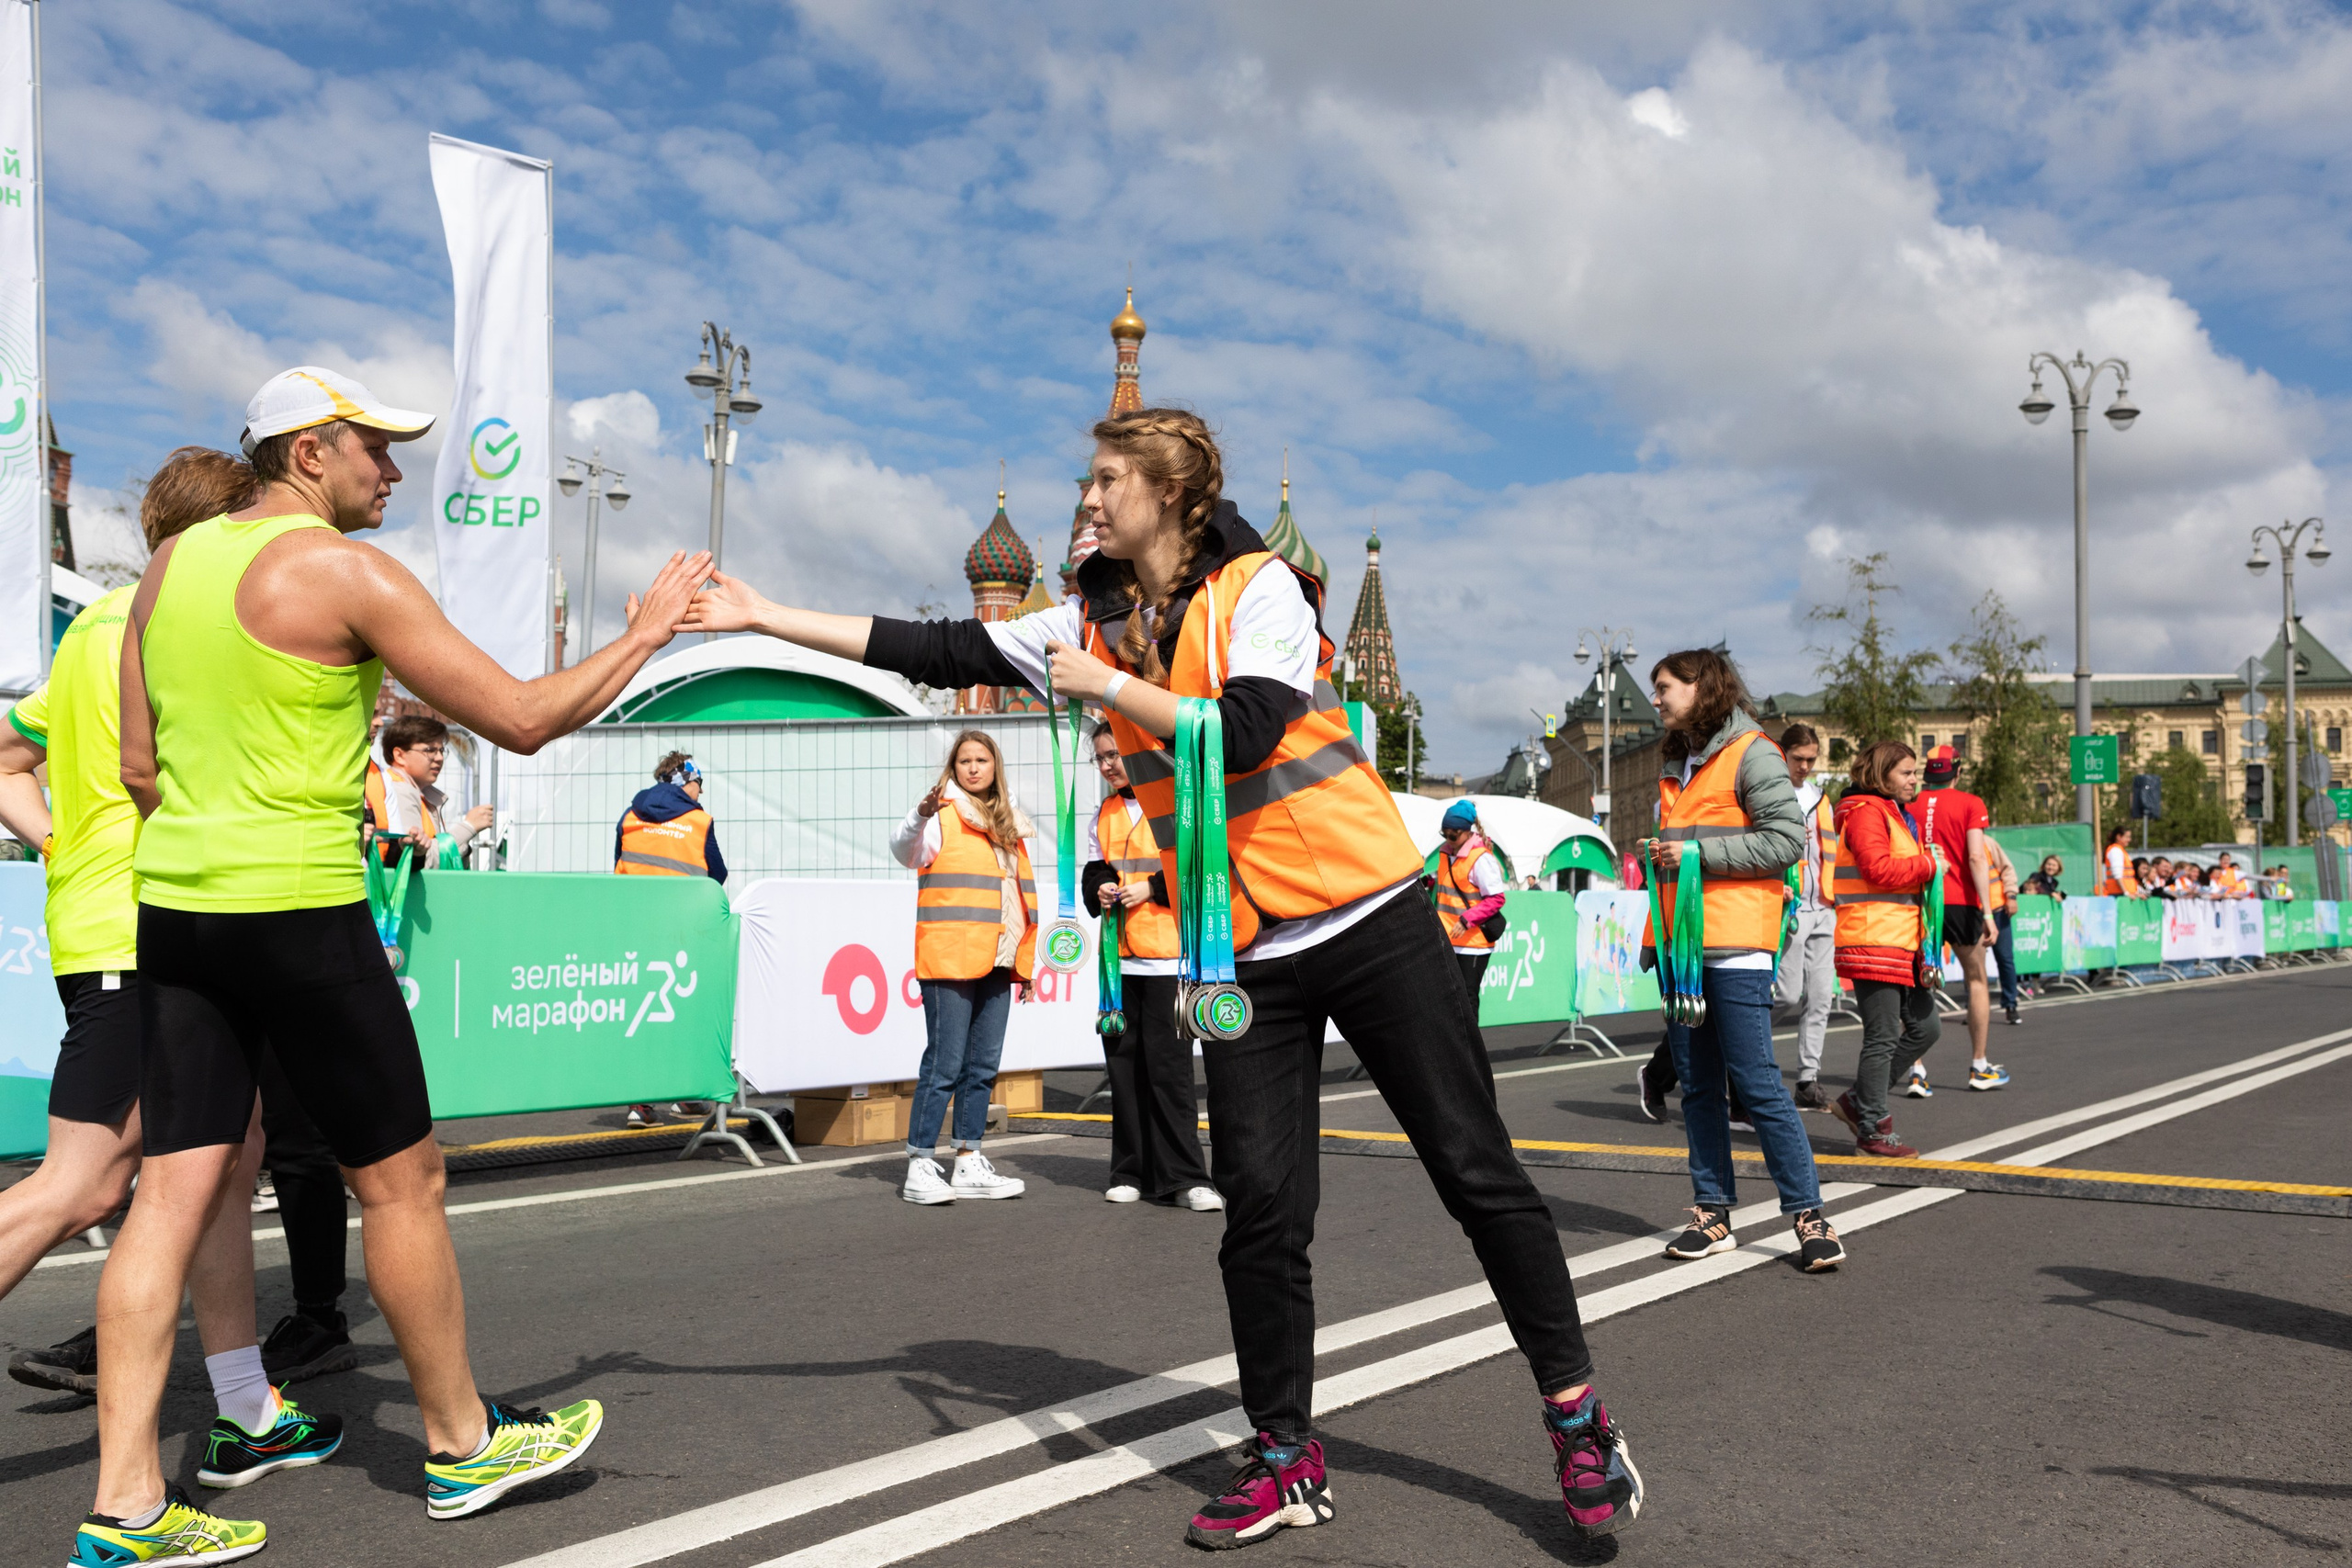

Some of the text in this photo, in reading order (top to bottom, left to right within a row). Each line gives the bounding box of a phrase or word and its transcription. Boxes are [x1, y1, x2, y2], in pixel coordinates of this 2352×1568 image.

[444, 491, 541, 527] СБЕР
[511, 952, 639, 991] зелёный
[492, 989, 626, 1035] марафон
[1557, 1417, 1584, 1427] adidas
